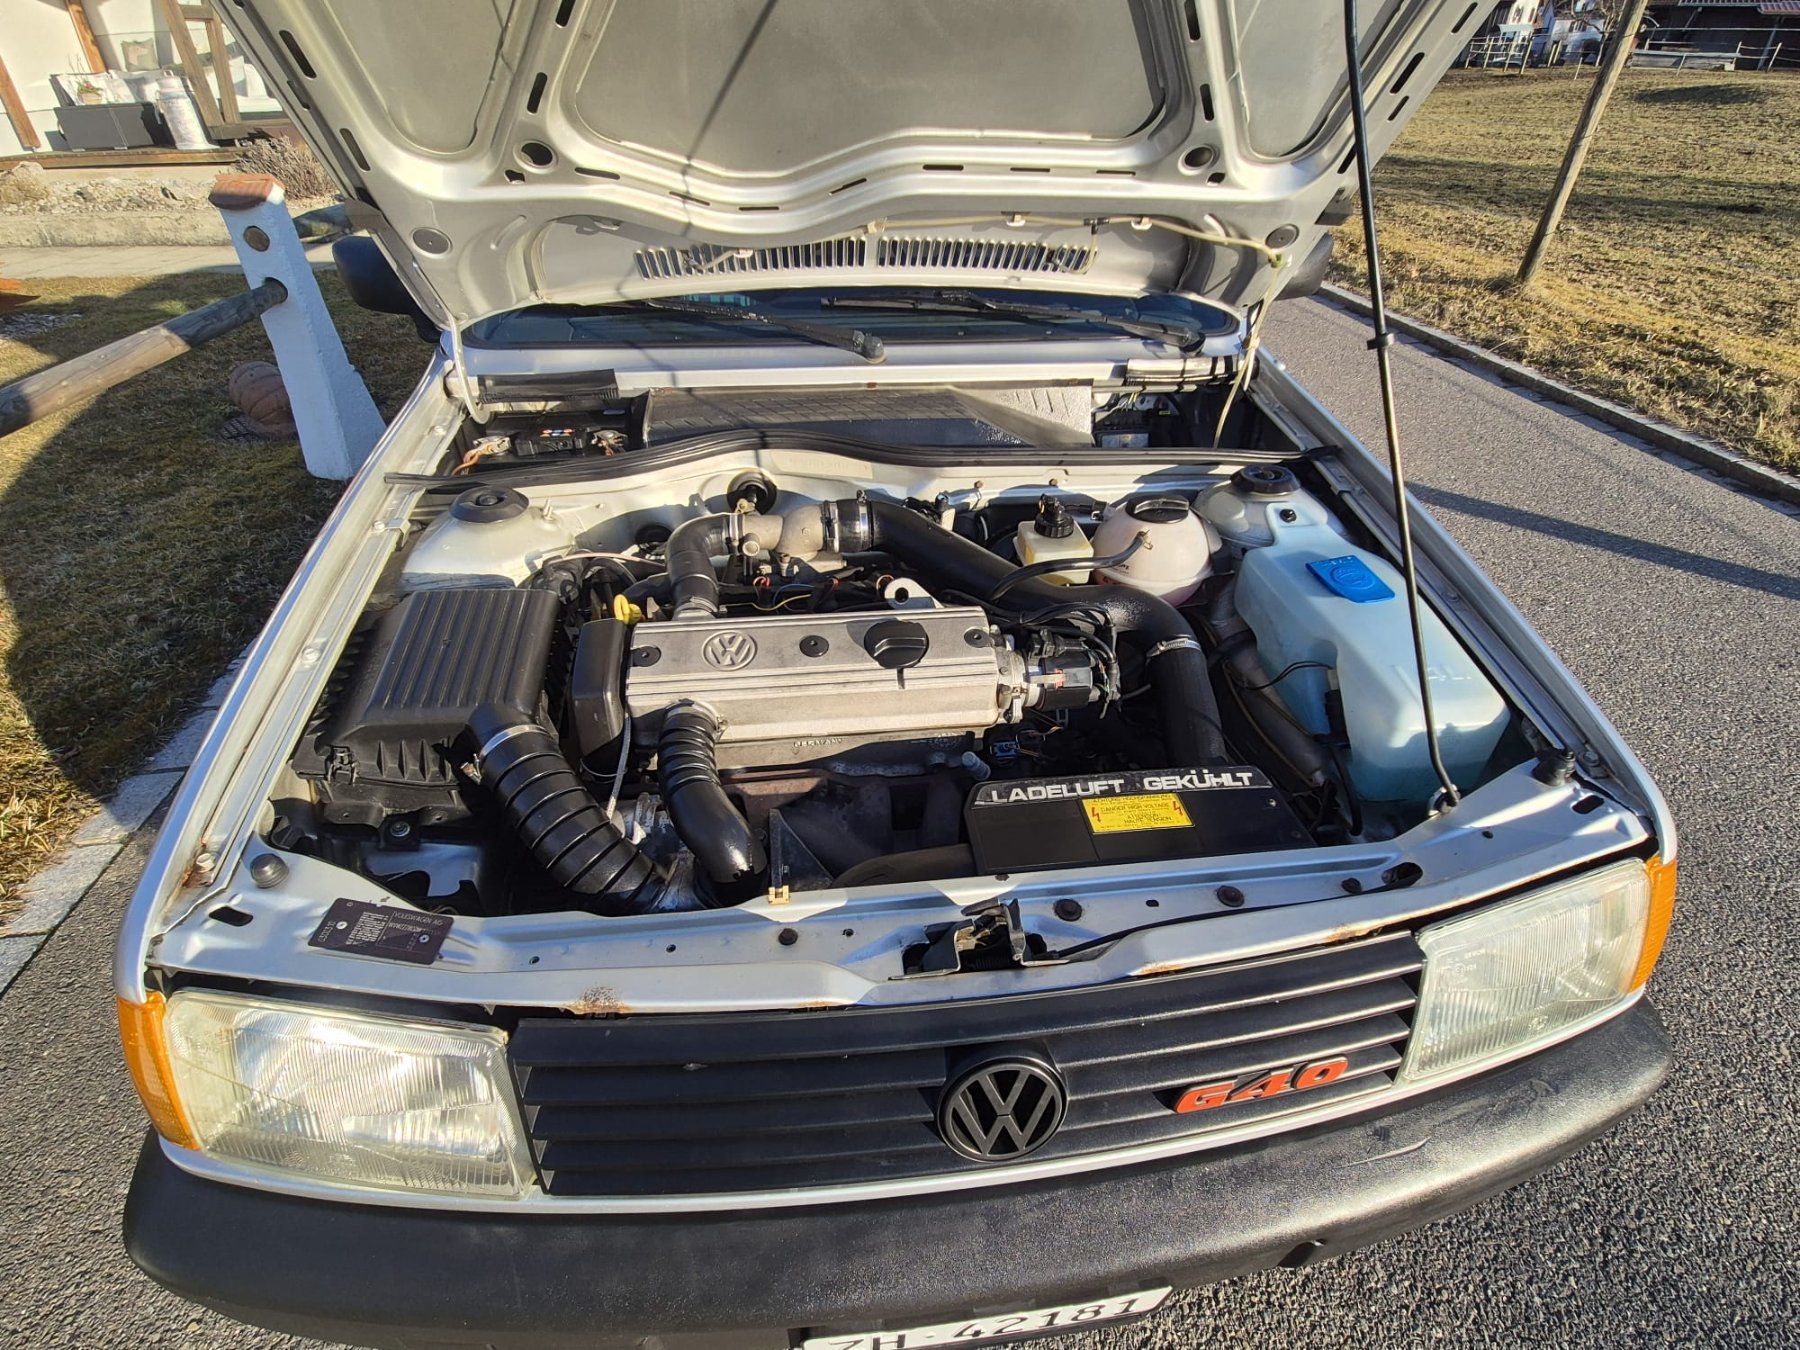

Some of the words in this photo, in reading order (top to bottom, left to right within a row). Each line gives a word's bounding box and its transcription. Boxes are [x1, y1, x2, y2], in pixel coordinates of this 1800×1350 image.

[704, 632, 756, 670] VW
[991, 779, 1124, 803] LADELUFT
[1143, 769, 1253, 790] GEKÜHLT
[393, 911, 431, 924] VOLKSWAGEN
[1175, 1055, 1349, 1114] G40
[943, 1063, 1063, 1160] VW
[953, 1298, 1140, 1338] 42181
